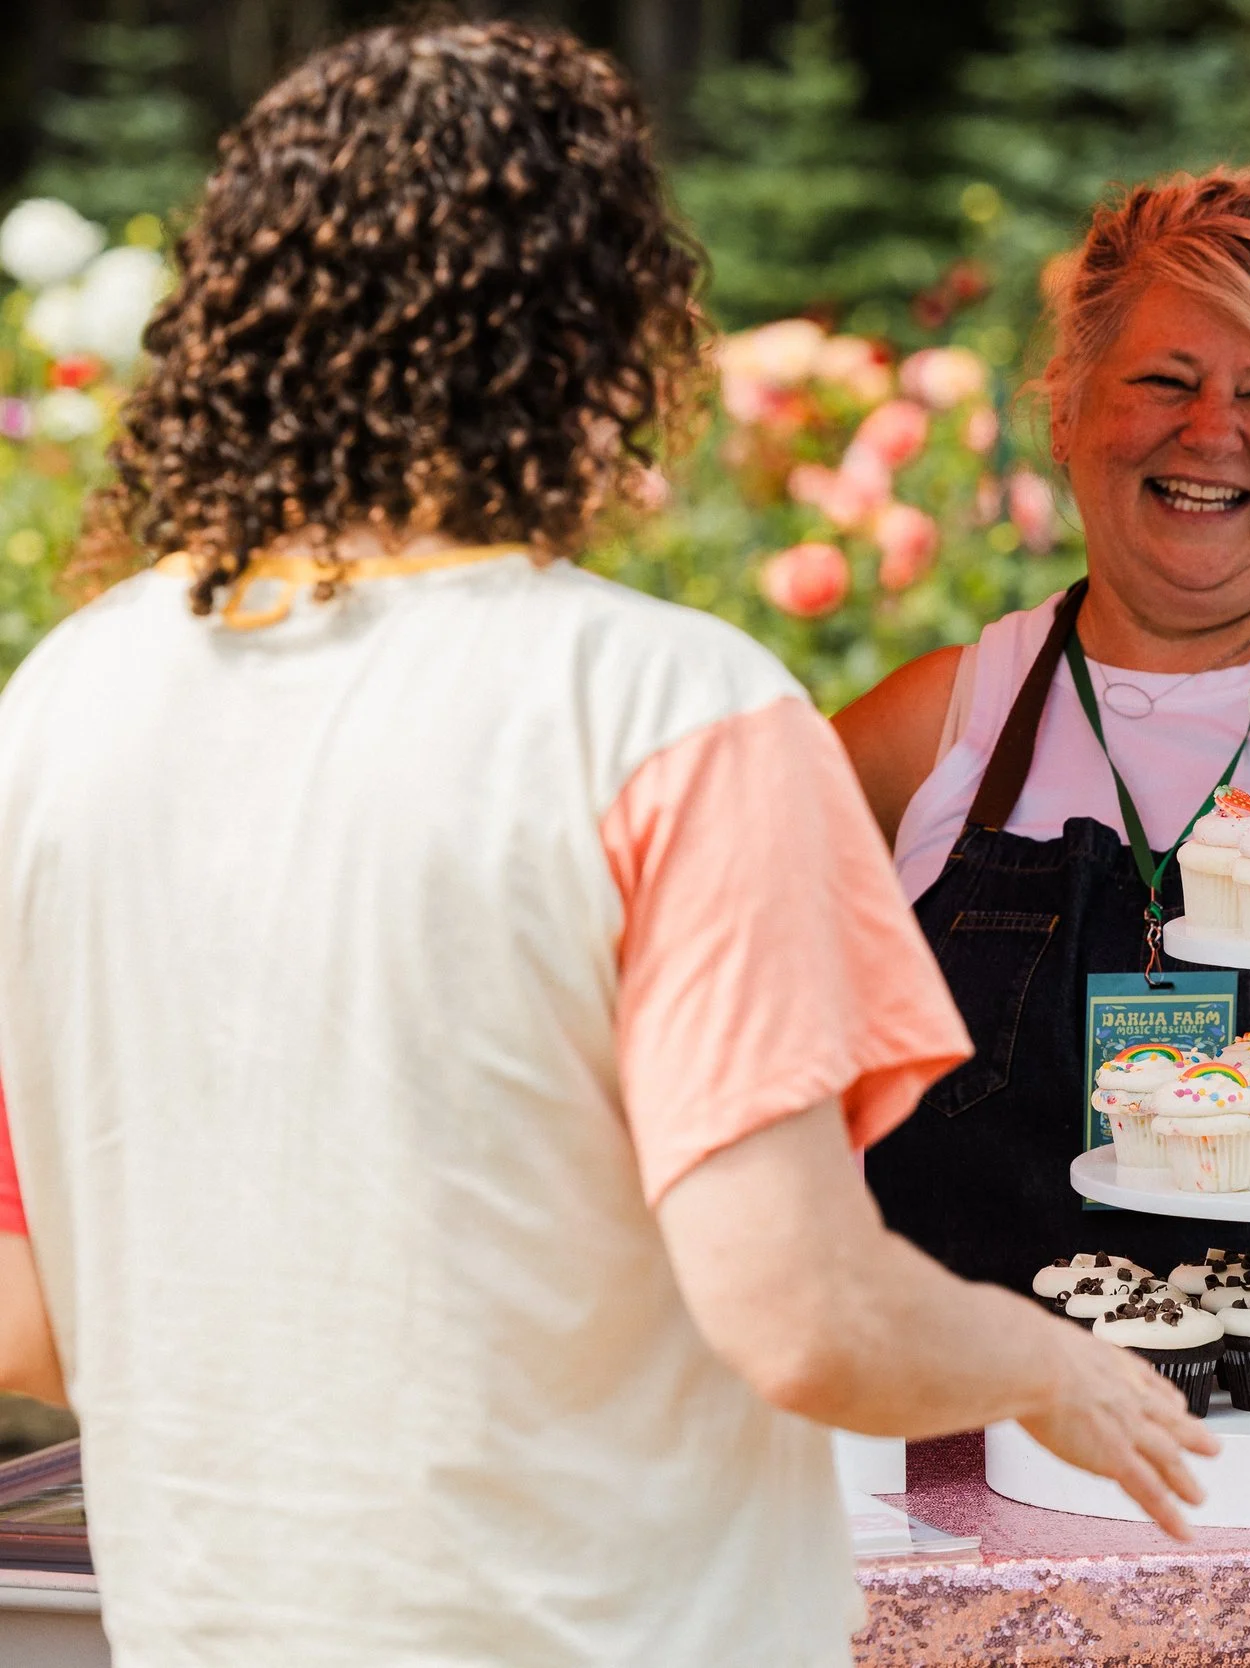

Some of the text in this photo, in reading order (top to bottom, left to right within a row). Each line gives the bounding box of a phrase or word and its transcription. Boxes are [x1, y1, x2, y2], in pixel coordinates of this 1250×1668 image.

[1102, 1010, 1221, 1027] DAHLIA FARM
[1116, 1026, 1151, 1035] MUSIC
